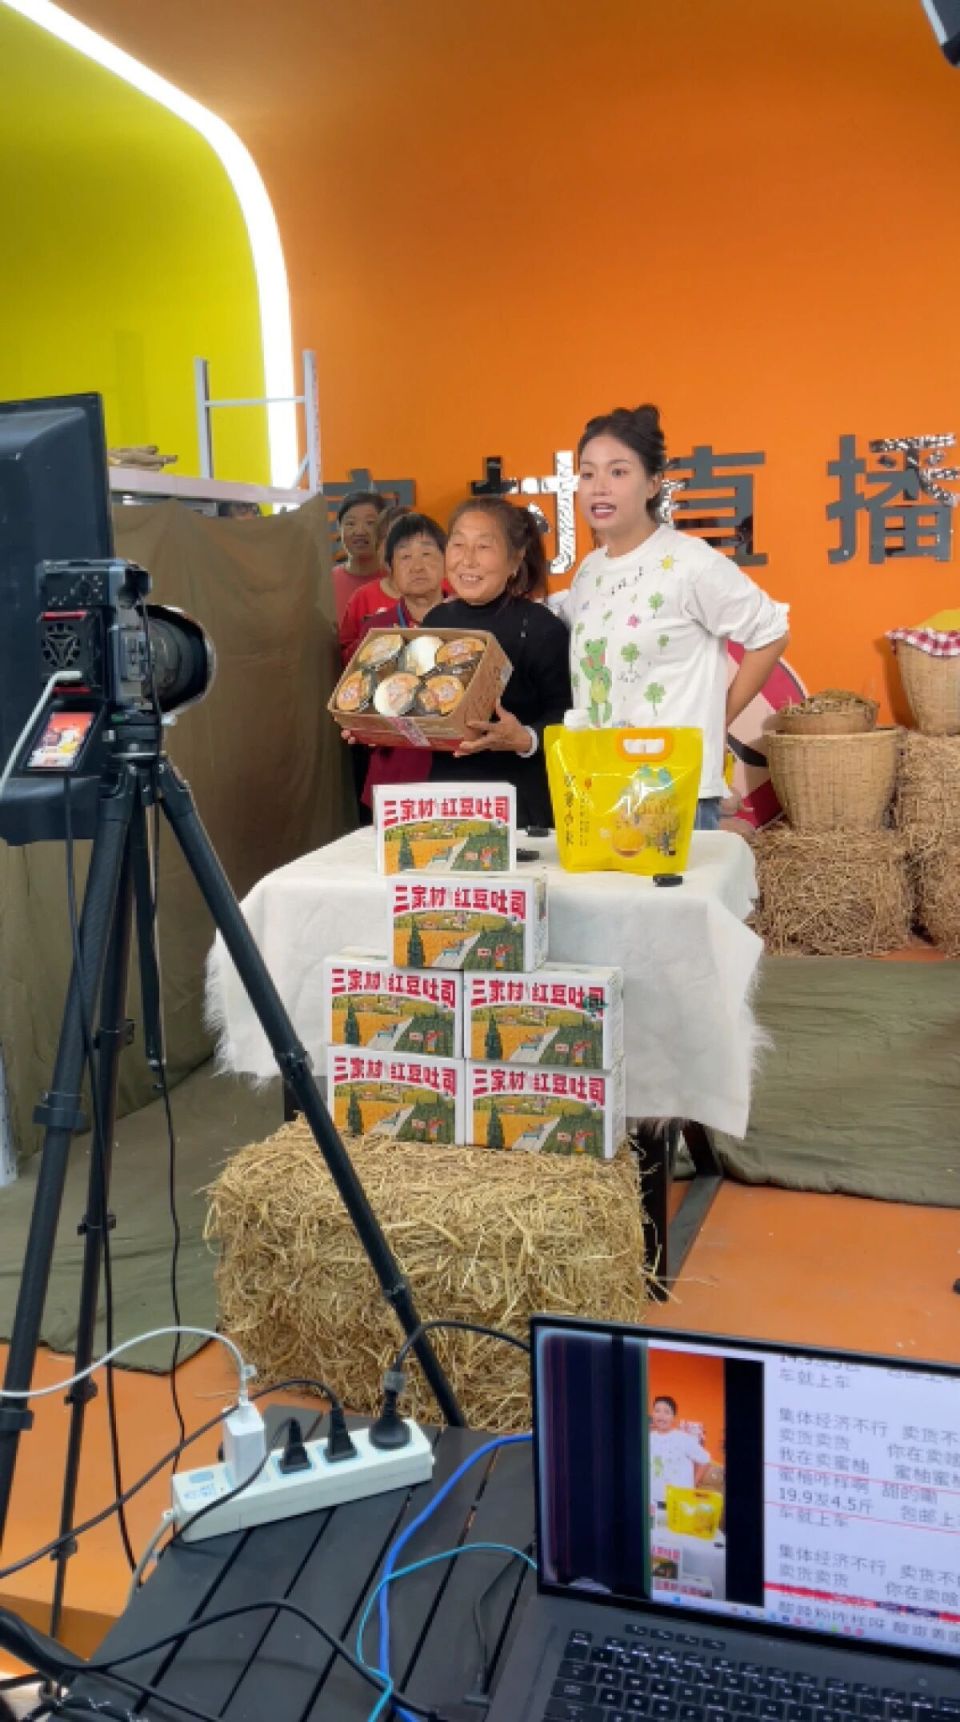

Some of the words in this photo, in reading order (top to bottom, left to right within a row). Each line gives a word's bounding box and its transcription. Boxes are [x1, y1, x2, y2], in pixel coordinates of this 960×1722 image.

[779, 1407, 889, 1438] 集体经济不行
[779, 1487, 872, 1514] 19.9发4.5斤
[779, 1543, 887, 1577] 集体经济不行
